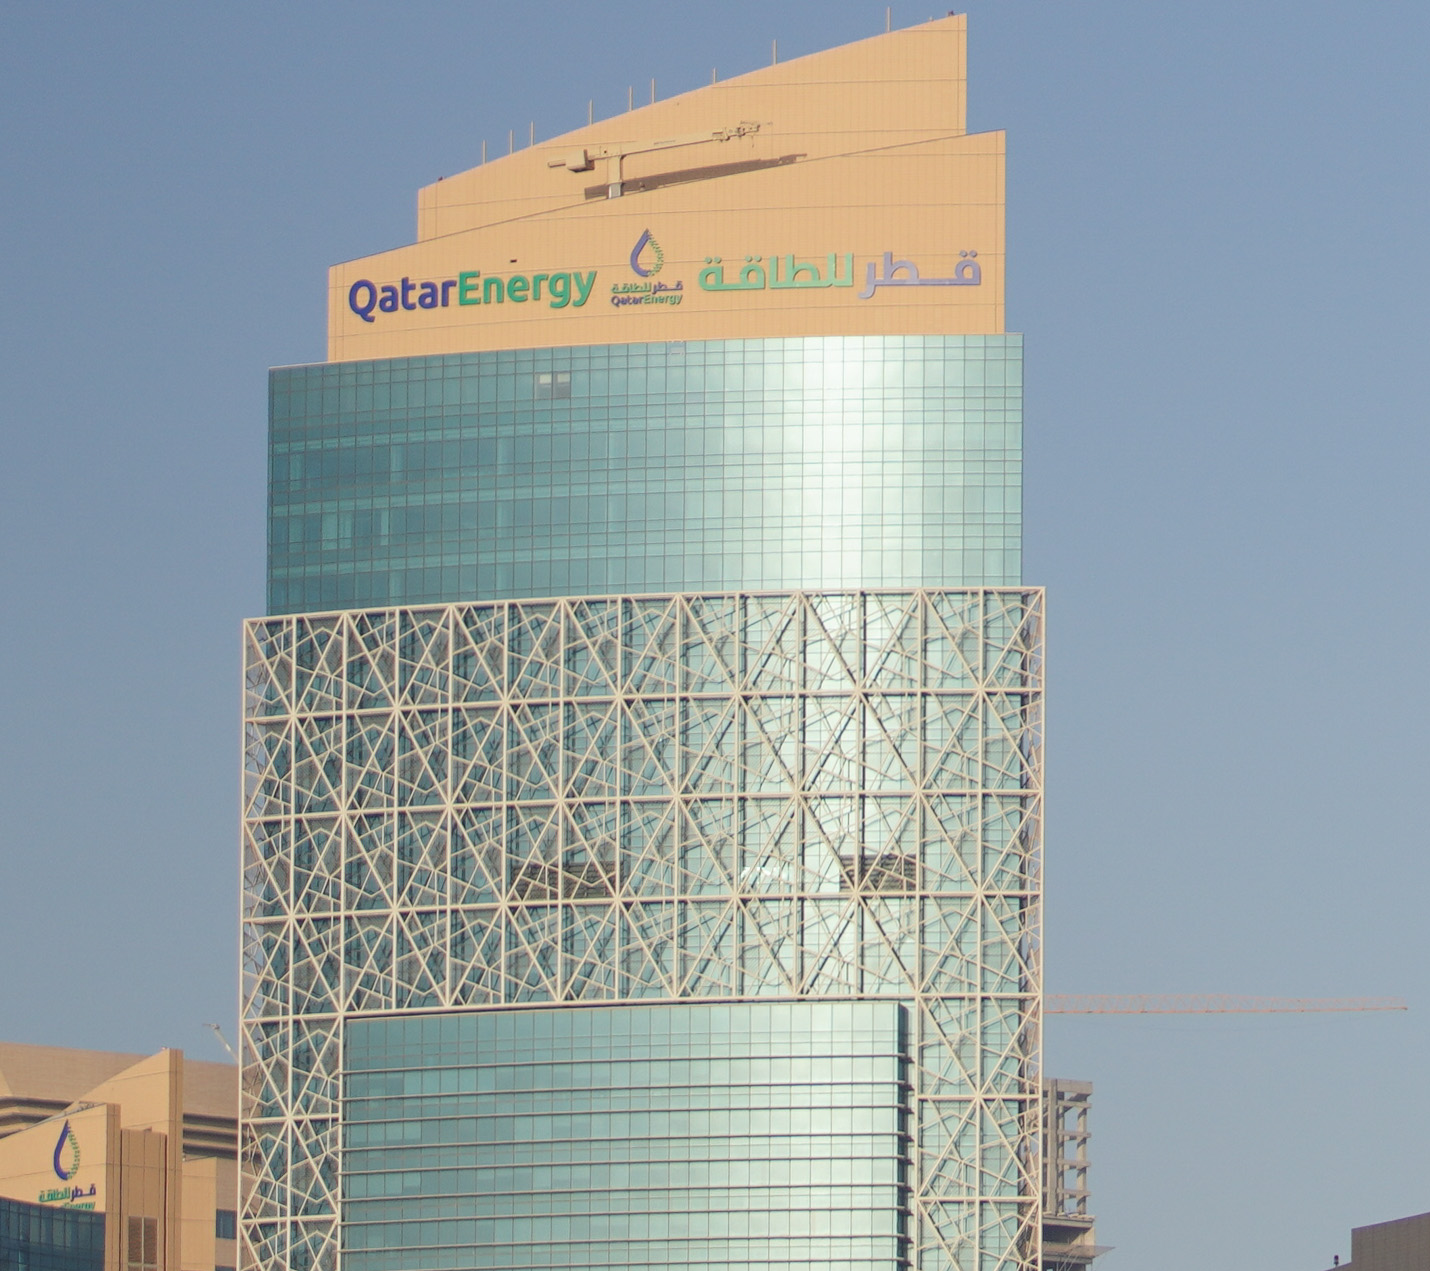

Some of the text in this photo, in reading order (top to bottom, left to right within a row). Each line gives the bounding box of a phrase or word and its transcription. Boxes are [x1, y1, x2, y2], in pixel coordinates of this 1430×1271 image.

[698, 250, 981, 299] قطر للطاقة
[348, 267, 598, 323] QatarEnergy
[652, 280, 684, 295] قطر
[611, 295, 684, 308] QatarEnergy
[70, 1183, 97, 1202] قطر
